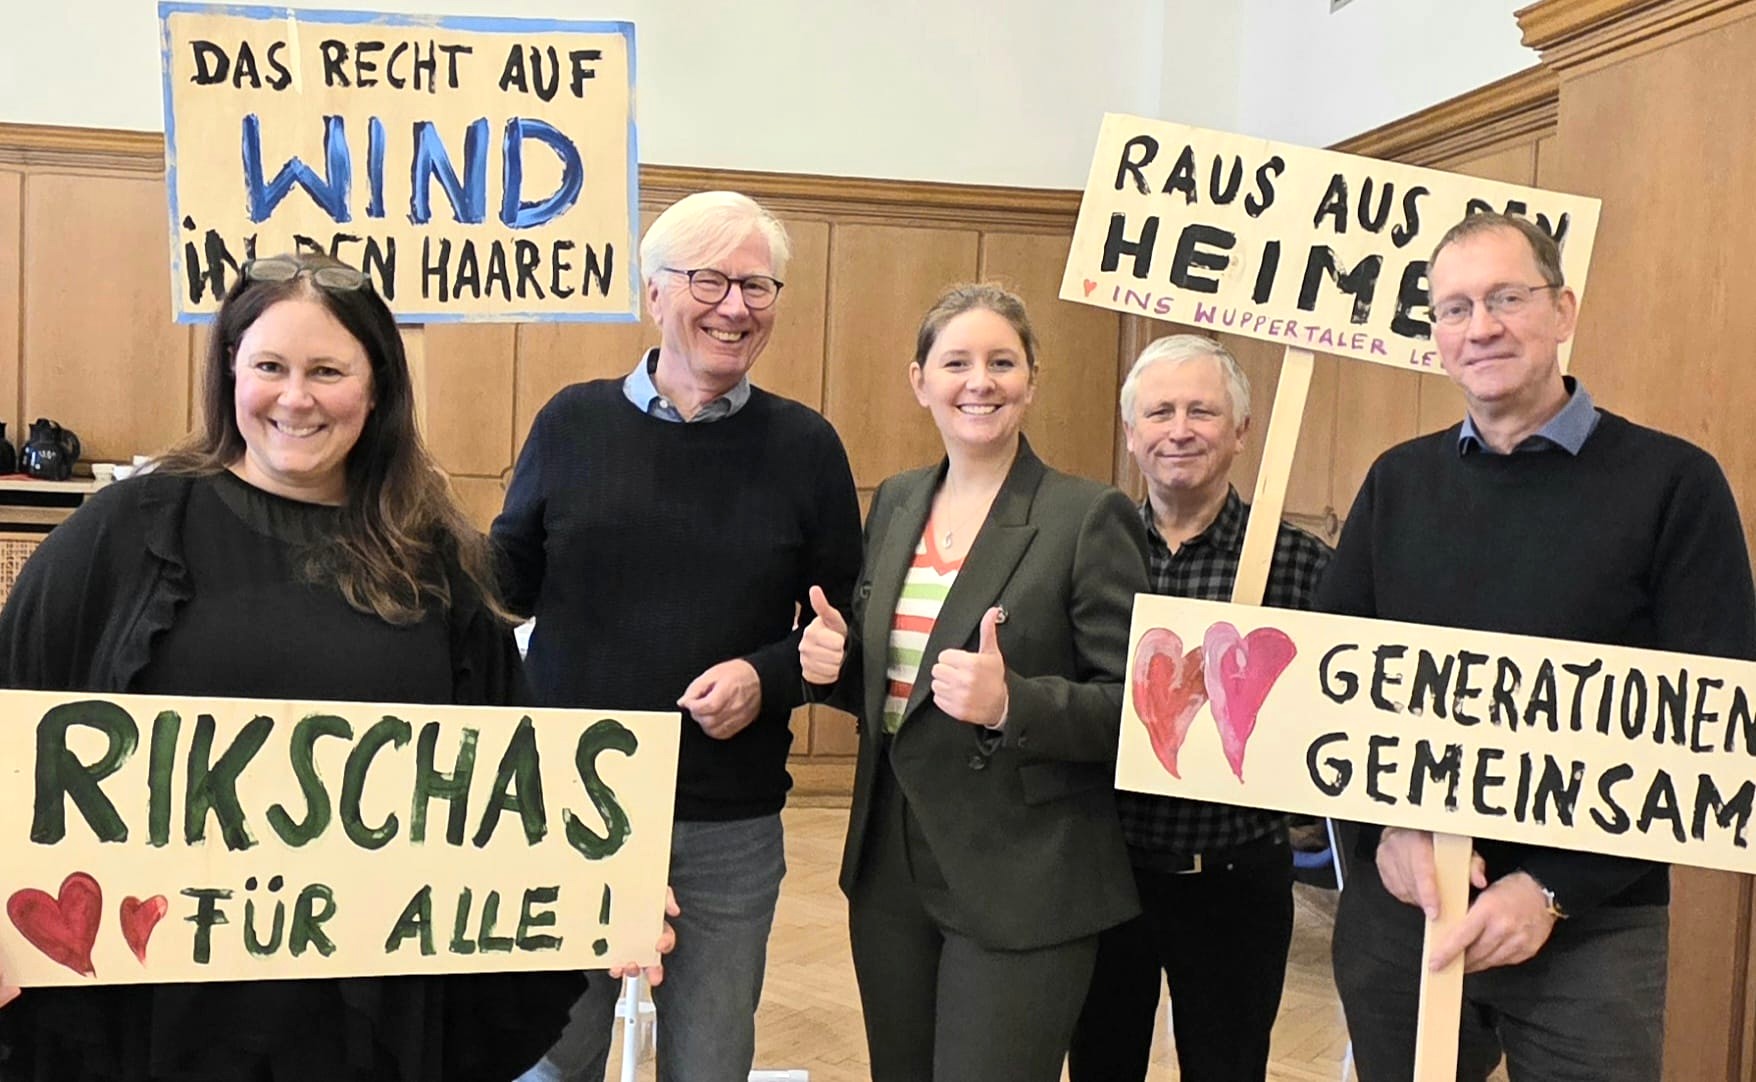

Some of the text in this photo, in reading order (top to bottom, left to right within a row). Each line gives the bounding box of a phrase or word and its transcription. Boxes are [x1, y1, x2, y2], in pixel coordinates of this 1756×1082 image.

[189, 40, 603, 102] DAS RECHT AUF
[241, 113, 584, 229] WIND
[1114, 135, 1286, 217] RAUS
[1313, 173, 1431, 248] AUS
[422, 236, 614, 302] HAAREN
[1100, 211, 1437, 339] HEIME
[1112, 285, 1443, 369] INS WUPPERTALER LE
[1319, 643, 1756, 758] GENERATIONEN
[30, 699, 639, 860] RIKSCHAS
[1306, 732, 1756, 849] GEMEINSAM
[180, 875, 337, 964] FÜR
[385, 884, 564, 956] ALLE
